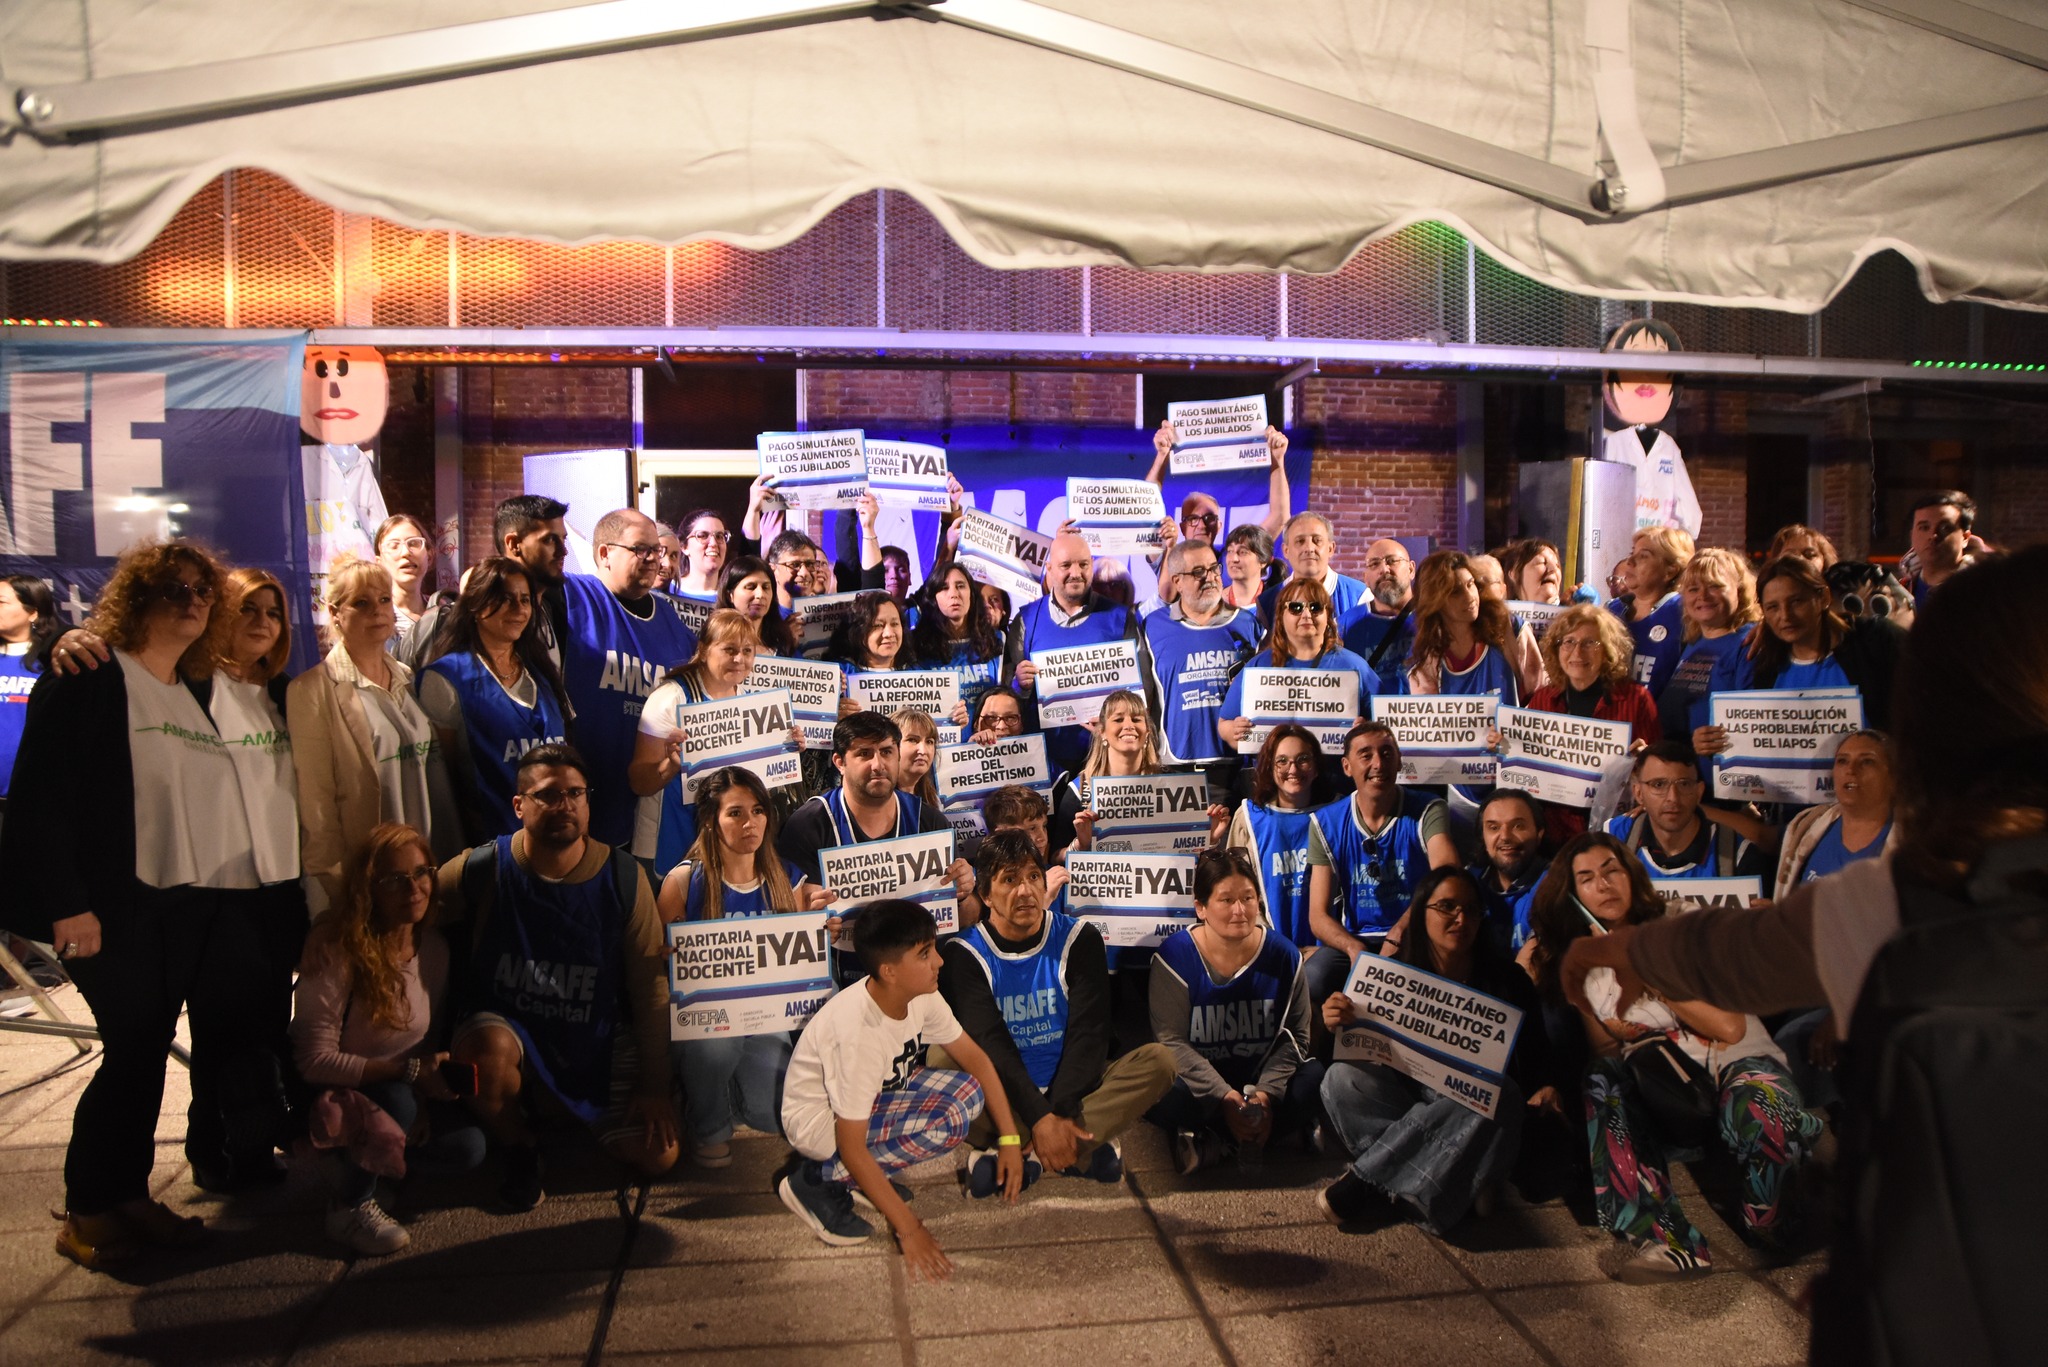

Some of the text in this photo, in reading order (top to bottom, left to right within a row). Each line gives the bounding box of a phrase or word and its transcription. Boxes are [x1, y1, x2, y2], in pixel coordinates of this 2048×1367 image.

[1177, 403, 1258, 417] PAGO SIMULTÁNEO
[1187, 418, 1203, 426] LOS
[1205, 415, 1253, 424] AUMENTOS
[1204, 425, 1251, 435] JUBILADOS
[768, 436, 855, 451] PAGO SIMULTÁNEO
[766, 448, 860, 463] DE LOS AUMENTOS A
[866, 448, 900, 456] RITARIA
[1239, 448, 1266, 459] AMSAFE
[779, 461, 850, 473] LOS JUBILADOS
[866, 457, 900, 466] CIONAL
[902, 454, 946, 476] ¡YA!
[867, 466, 900, 476] CENTE
[1102, 484, 1154, 495] SIMULTÁNEO
[919, 496, 946, 504] AMSAFE
[1103, 507, 1151, 515] JUBILADOS
[966, 514, 1007, 535] PARITARIA
[965, 523, 1004, 545] NACIONAL
[964, 531, 1003, 554] DOCENTE
[1005, 534, 1047, 567] ¡YA!
[1016, 579, 1037, 595] AMSAFE
[678, 601, 698, 614] LEY
[804, 603, 843, 613] URGENTE
[1046, 647, 1124, 666] NUEVA LEY DE
[770, 665, 833, 680] SIMULTÁNEO
[1039, 658, 1134, 678] FINANCIAMIENTO
[751, 676, 770, 687] LOS
[773, 680, 825, 693] AUMENTOS
[827, 685, 835, 693] A
[860, 675, 950, 689] DEROGACIÓN DE
[1057, 672, 1119, 688] EDUCATIVO
[1260, 674, 1340, 687] DEROGACIÓN
[870, 691, 941, 702] LA REFORMA
[1289, 688, 1311, 699] DEL
[1255, 700, 1344, 712] PRESENTISMO
[1388, 702, 1484, 714] NUEVA LEY DE
[1726, 706, 1846, 720] URGENTE SOLUCIÓN
[684, 707, 740, 726] PARITARIA
[743, 702, 793, 738] ¡YA!
[685, 720, 741, 738] NACIONAL
[804, 727, 832, 739] AMSAFE
[1512, 714, 1612, 740] NUEVA LEY DE
[1727, 724, 1748, 733] LAS
[1751, 721, 1857, 734] PROBLEMÁTICAS
[686, 732, 741, 753] DOCENTE
[1398, 730, 1475, 742] EDUCATIVO
[1501, 727, 1624, 756] FINANCIAMIENTO
[1754, 738, 1817, 749] DEL IAPOS
[952, 741, 1028, 762] DEROGACIÓN
[1523, 743, 1601, 767] EDUCATIVO
[766, 759, 797, 777] AMSAFE
[982, 759, 1004, 771] DEL
[951, 767, 1035, 787] PRESENTISMO
[1097, 784, 1153, 795] PARITARIA
[1098, 796, 1154, 807] NACIONAL
[1156, 786, 1208, 813] ¡YA!
[1098, 807, 1154, 819] DOCENTE
[1173, 837, 1206, 849] AMSAFE
[827, 852, 893, 872] PARITARIA
[896, 846, 951, 886] ¡YA!
[1072, 862, 1132, 872] PARITARIA
[829, 866, 896, 887] NACIONAL
[1071, 874, 1132, 885] NACIONAL
[1135, 868, 1193, 895] ¡YA!
[1071, 886, 1132, 898] DOCENTE
[676, 930, 752, 948] PARITARIA
[677, 946, 754, 964] NACIONAL
[757, 929, 826, 968] ¡YA!
[677, 960, 755, 980] DOCENTE
[1365, 966, 1507, 1025] PAGO SIMULTÁNEO
[1354, 980, 1505, 1044] DE LOS AUMENTOS A
[1190, 999, 1275, 1042] AMSAFE
[1368, 1002, 1481, 1054] LOS JUBILADOS
[1444, 1075, 1492, 1106] AMSAFE
